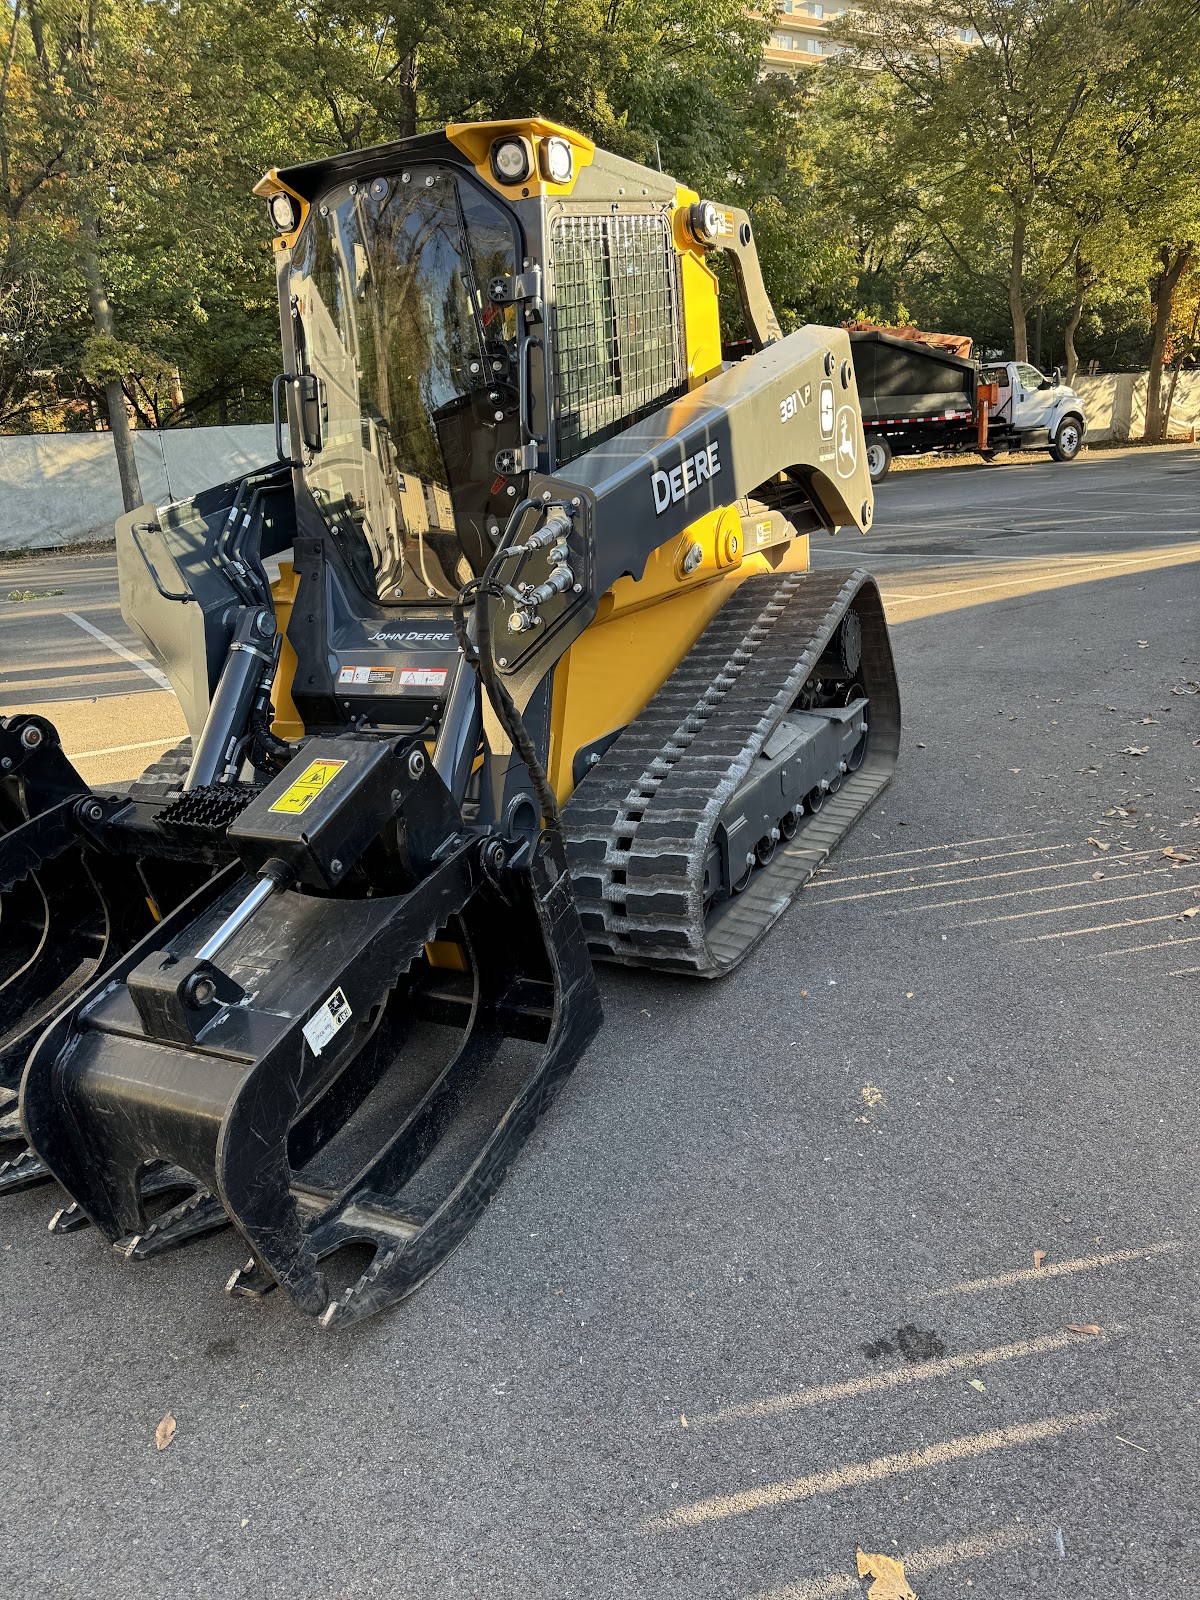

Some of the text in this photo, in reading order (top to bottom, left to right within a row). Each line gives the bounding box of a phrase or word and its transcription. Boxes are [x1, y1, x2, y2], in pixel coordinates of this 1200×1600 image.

[779, 384, 811, 424] 331 P
[651, 440, 721, 515] DEERE
[368, 632, 453, 641] JOHN DEERE
